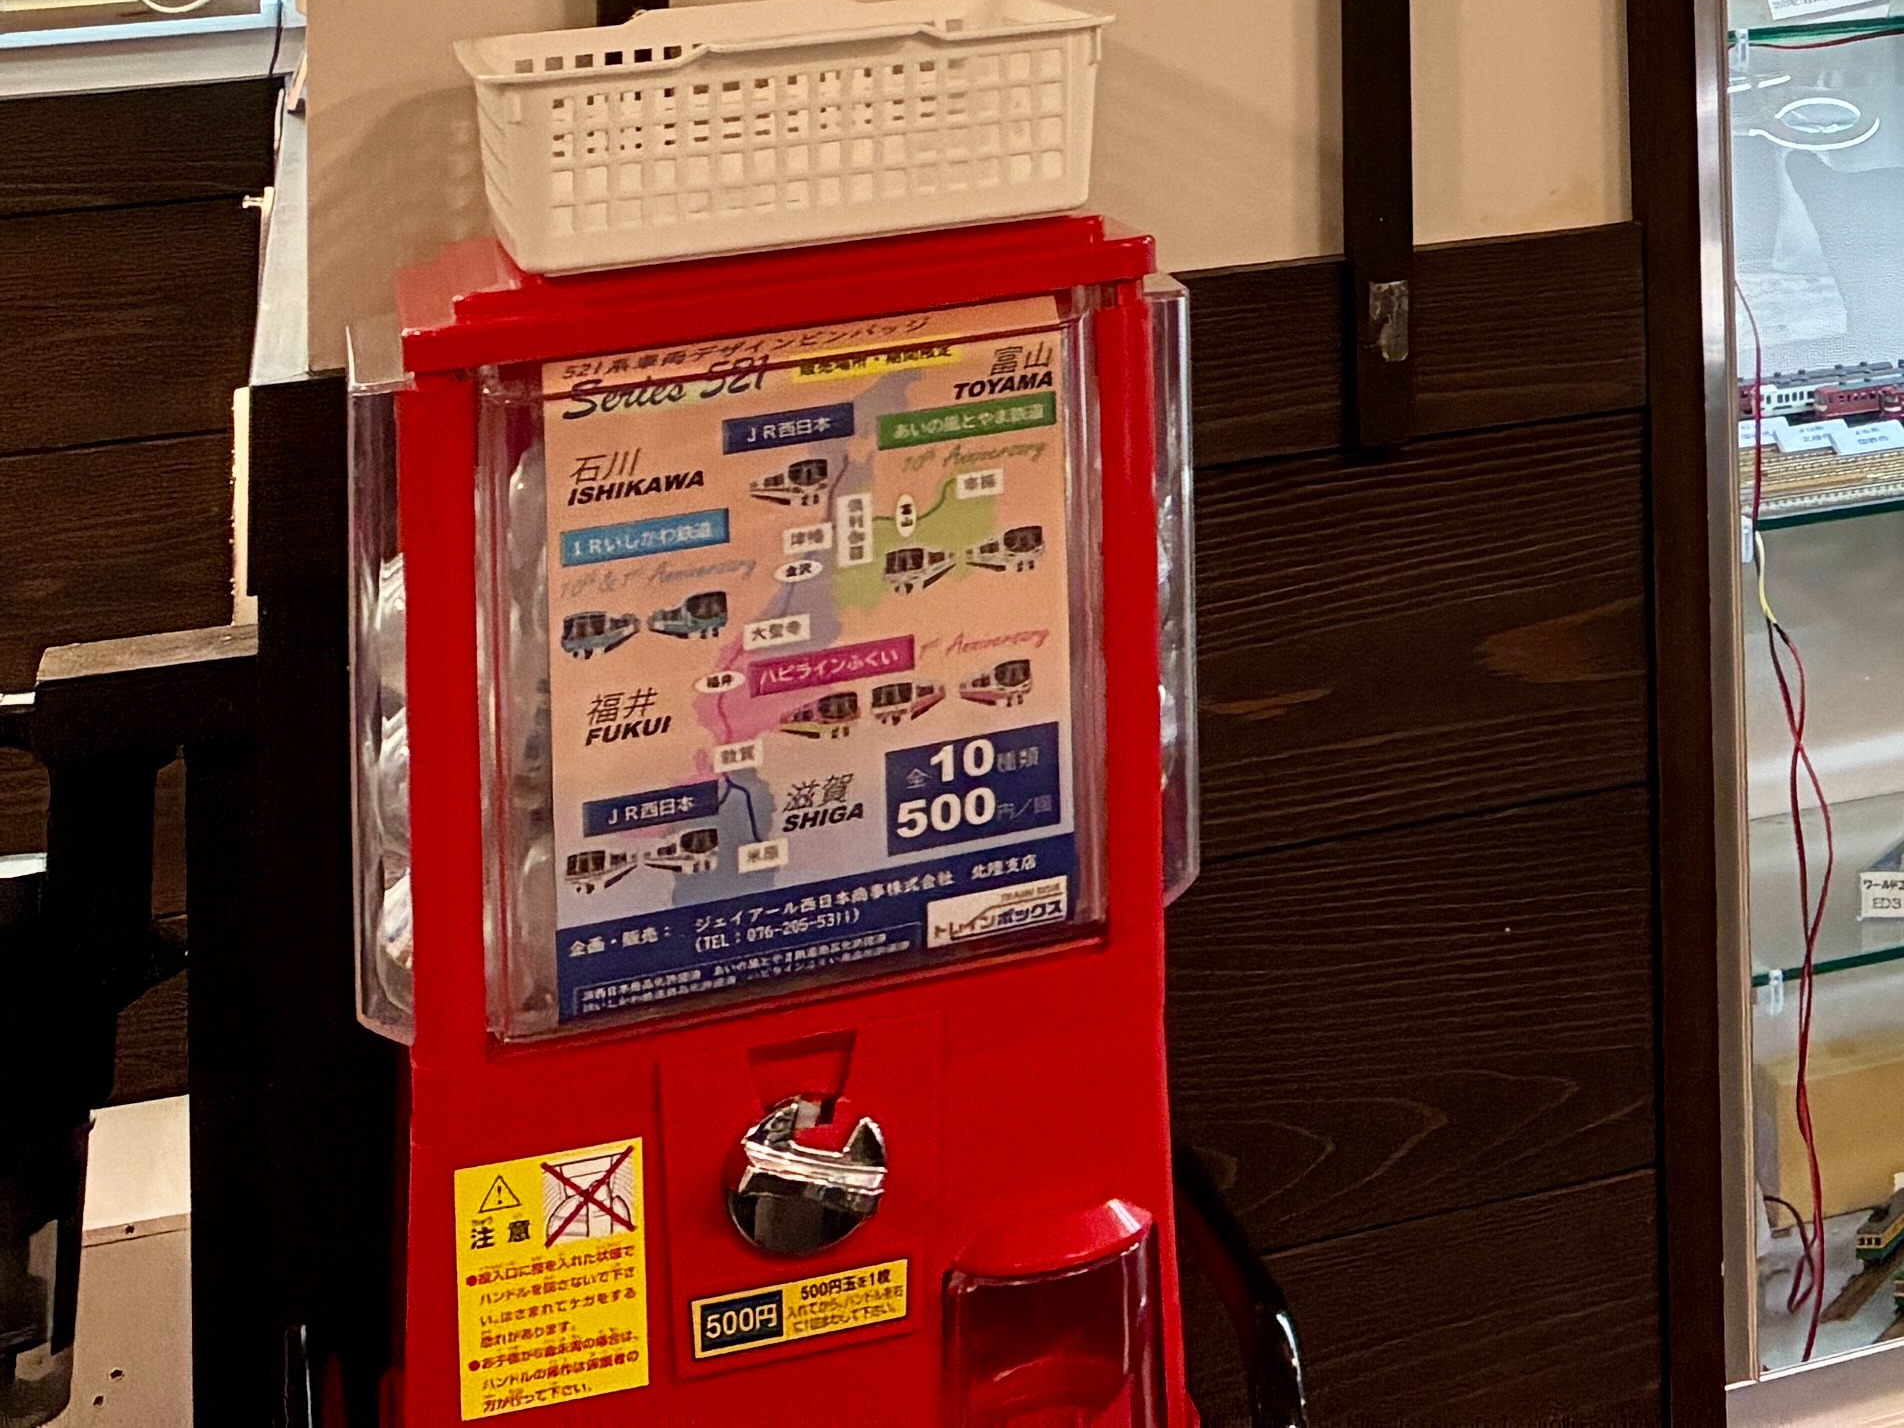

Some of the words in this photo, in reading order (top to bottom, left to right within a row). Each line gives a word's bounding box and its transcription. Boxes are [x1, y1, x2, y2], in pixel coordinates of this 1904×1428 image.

[991, 341, 1054, 377] 富山
[952, 371, 1053, 401] TOYAMA
[569, 447, 642, 486] 石川
[567, 470, 706, 507] ISHIKAWA
[758, 647, 901, 688] ハピラインふくい
[587, 687, 659, 726] 福井
[585, 715, 672, 747] FUKUI
[782, 772, 855, 813] 滋賀
[782, 802, 864, 834] SHIGA
[470, 1218, 531, 1250] 注意
[704, 1302, 778, 1340] 500円
